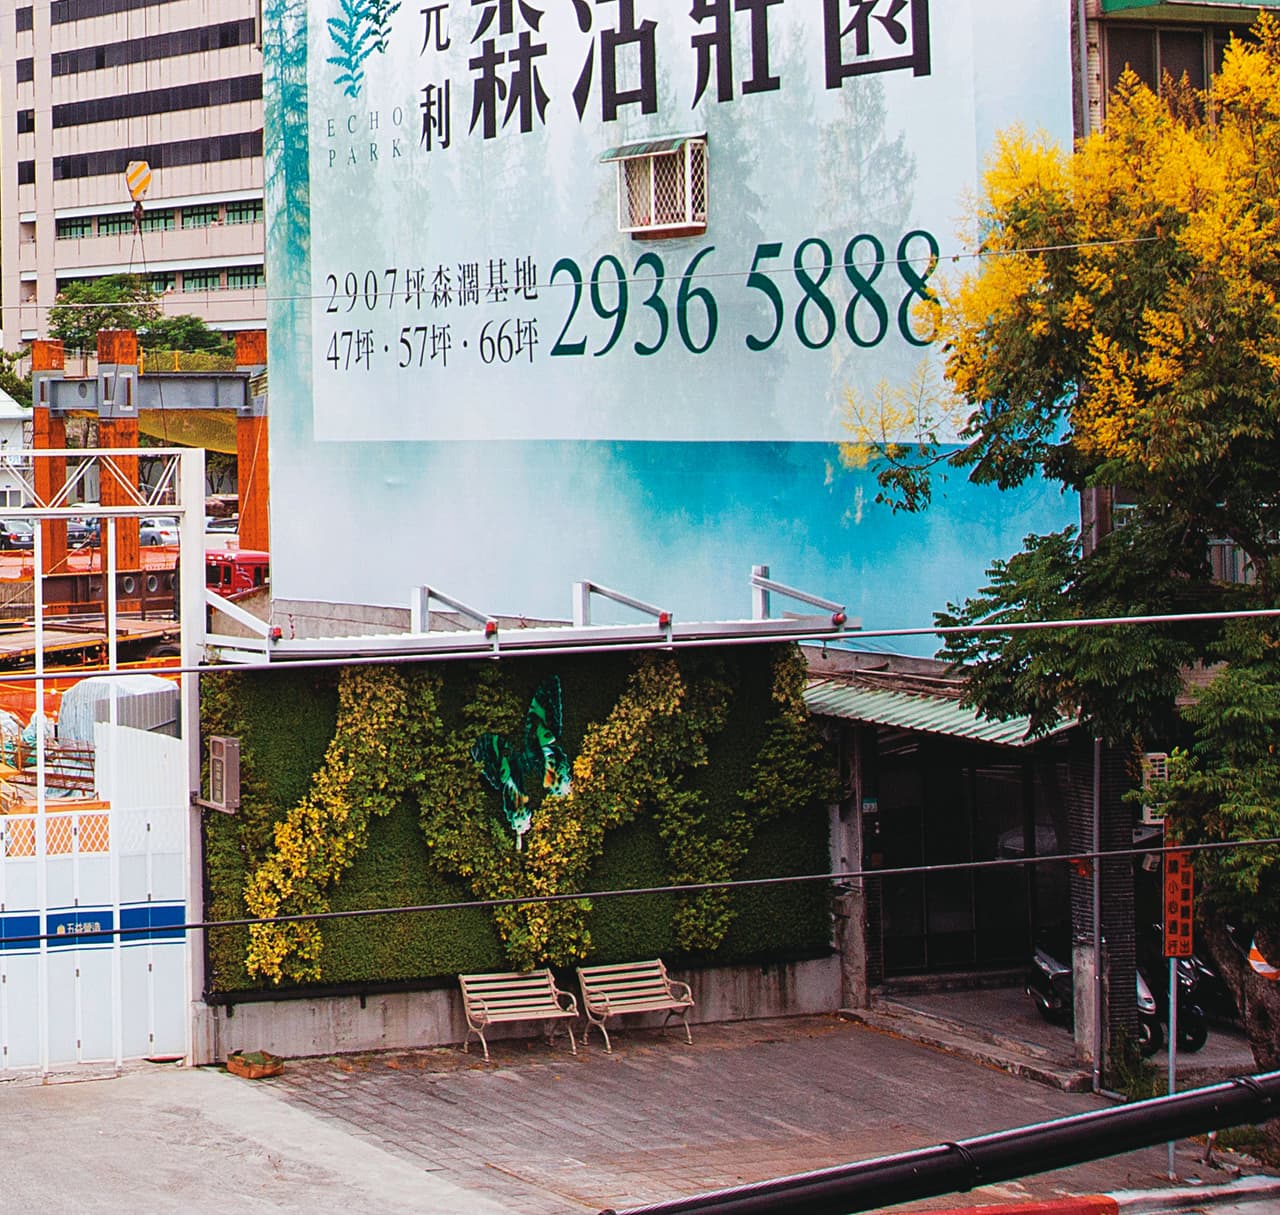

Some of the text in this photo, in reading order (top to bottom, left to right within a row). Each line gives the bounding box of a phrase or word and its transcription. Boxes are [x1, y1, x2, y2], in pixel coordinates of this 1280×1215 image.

[327, 106, 403, 138] ECHO
[328, 138, 402, 168] PARK
[549, 230, 942, 357] 2936 5888
